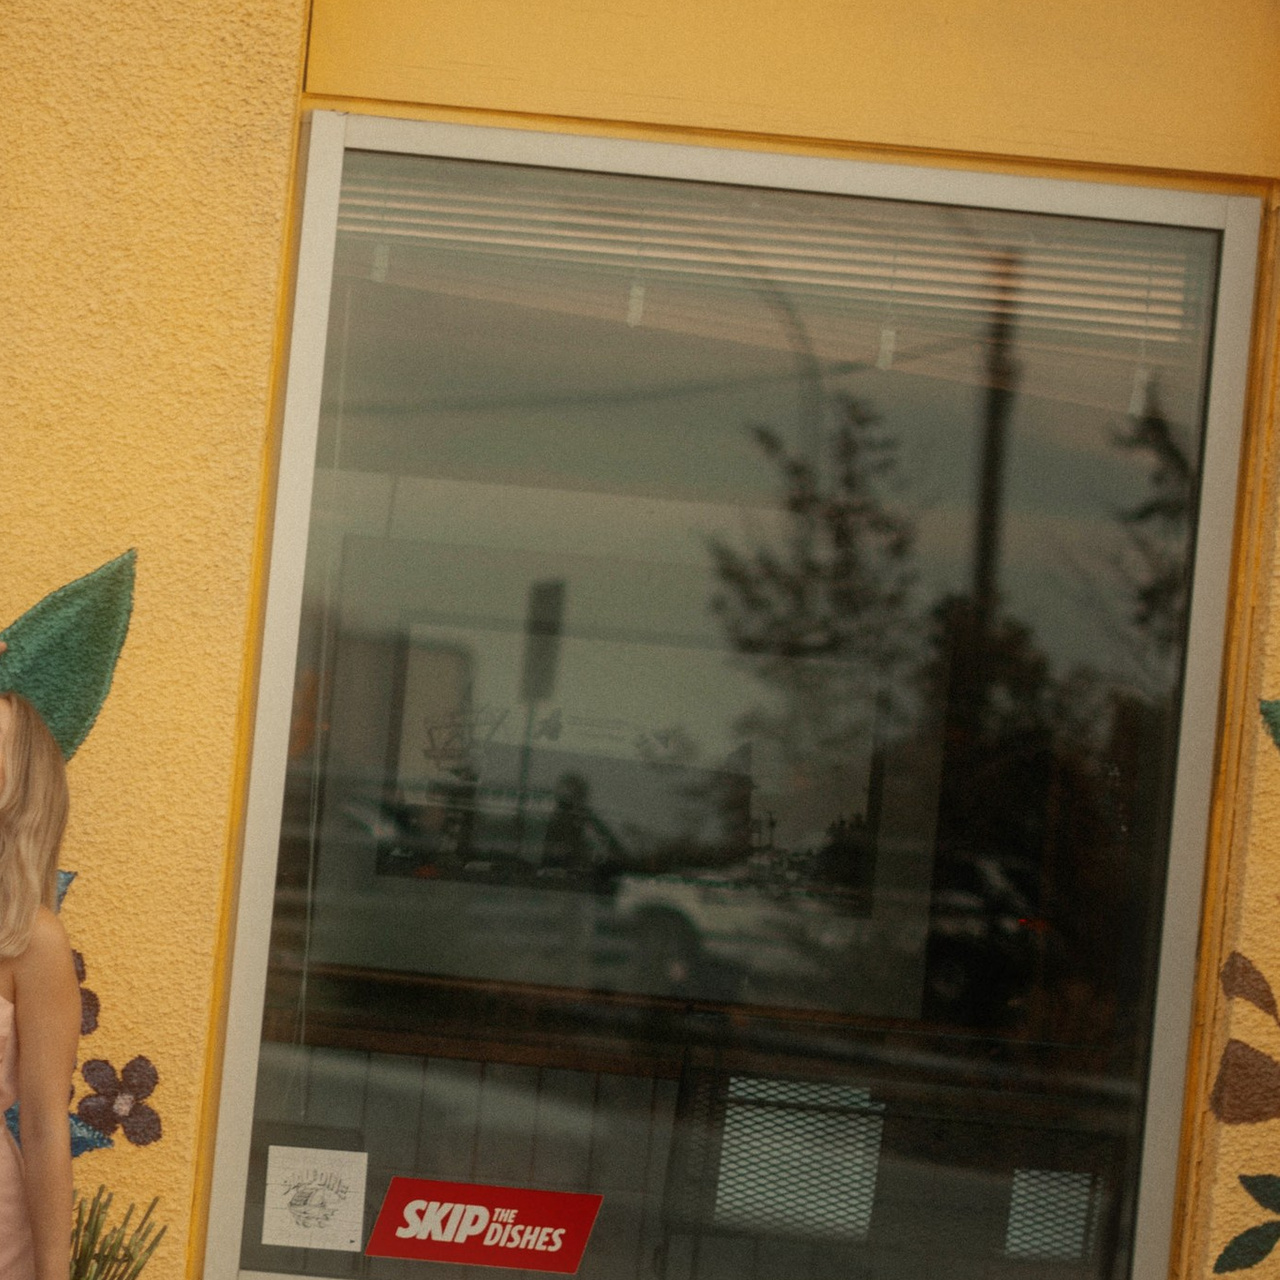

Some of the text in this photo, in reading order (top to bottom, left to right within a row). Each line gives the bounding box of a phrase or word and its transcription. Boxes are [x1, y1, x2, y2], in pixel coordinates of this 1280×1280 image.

[395, 1199, 519, 1244] SKIP THE
[482, 1222, 567, 1253] DISHES
